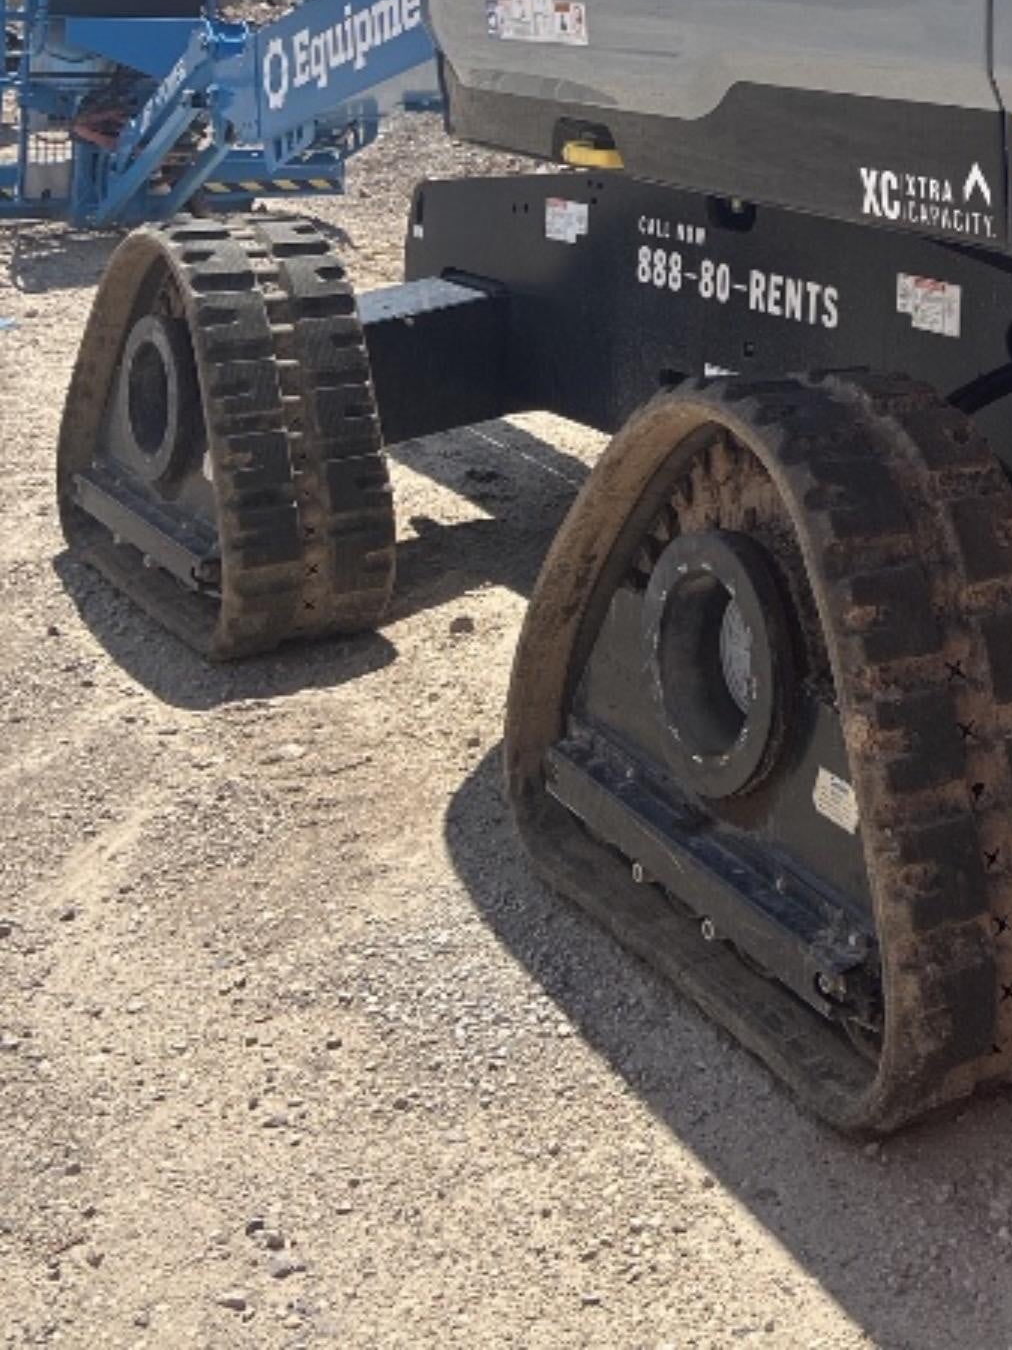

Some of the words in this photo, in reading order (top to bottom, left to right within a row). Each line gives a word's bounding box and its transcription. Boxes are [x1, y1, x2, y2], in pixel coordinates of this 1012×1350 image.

[860, 167, 900, 220] XC
[905, 173, 953, 203] XTRA
[638, 246, 838, 328] 888-80-RENTS
